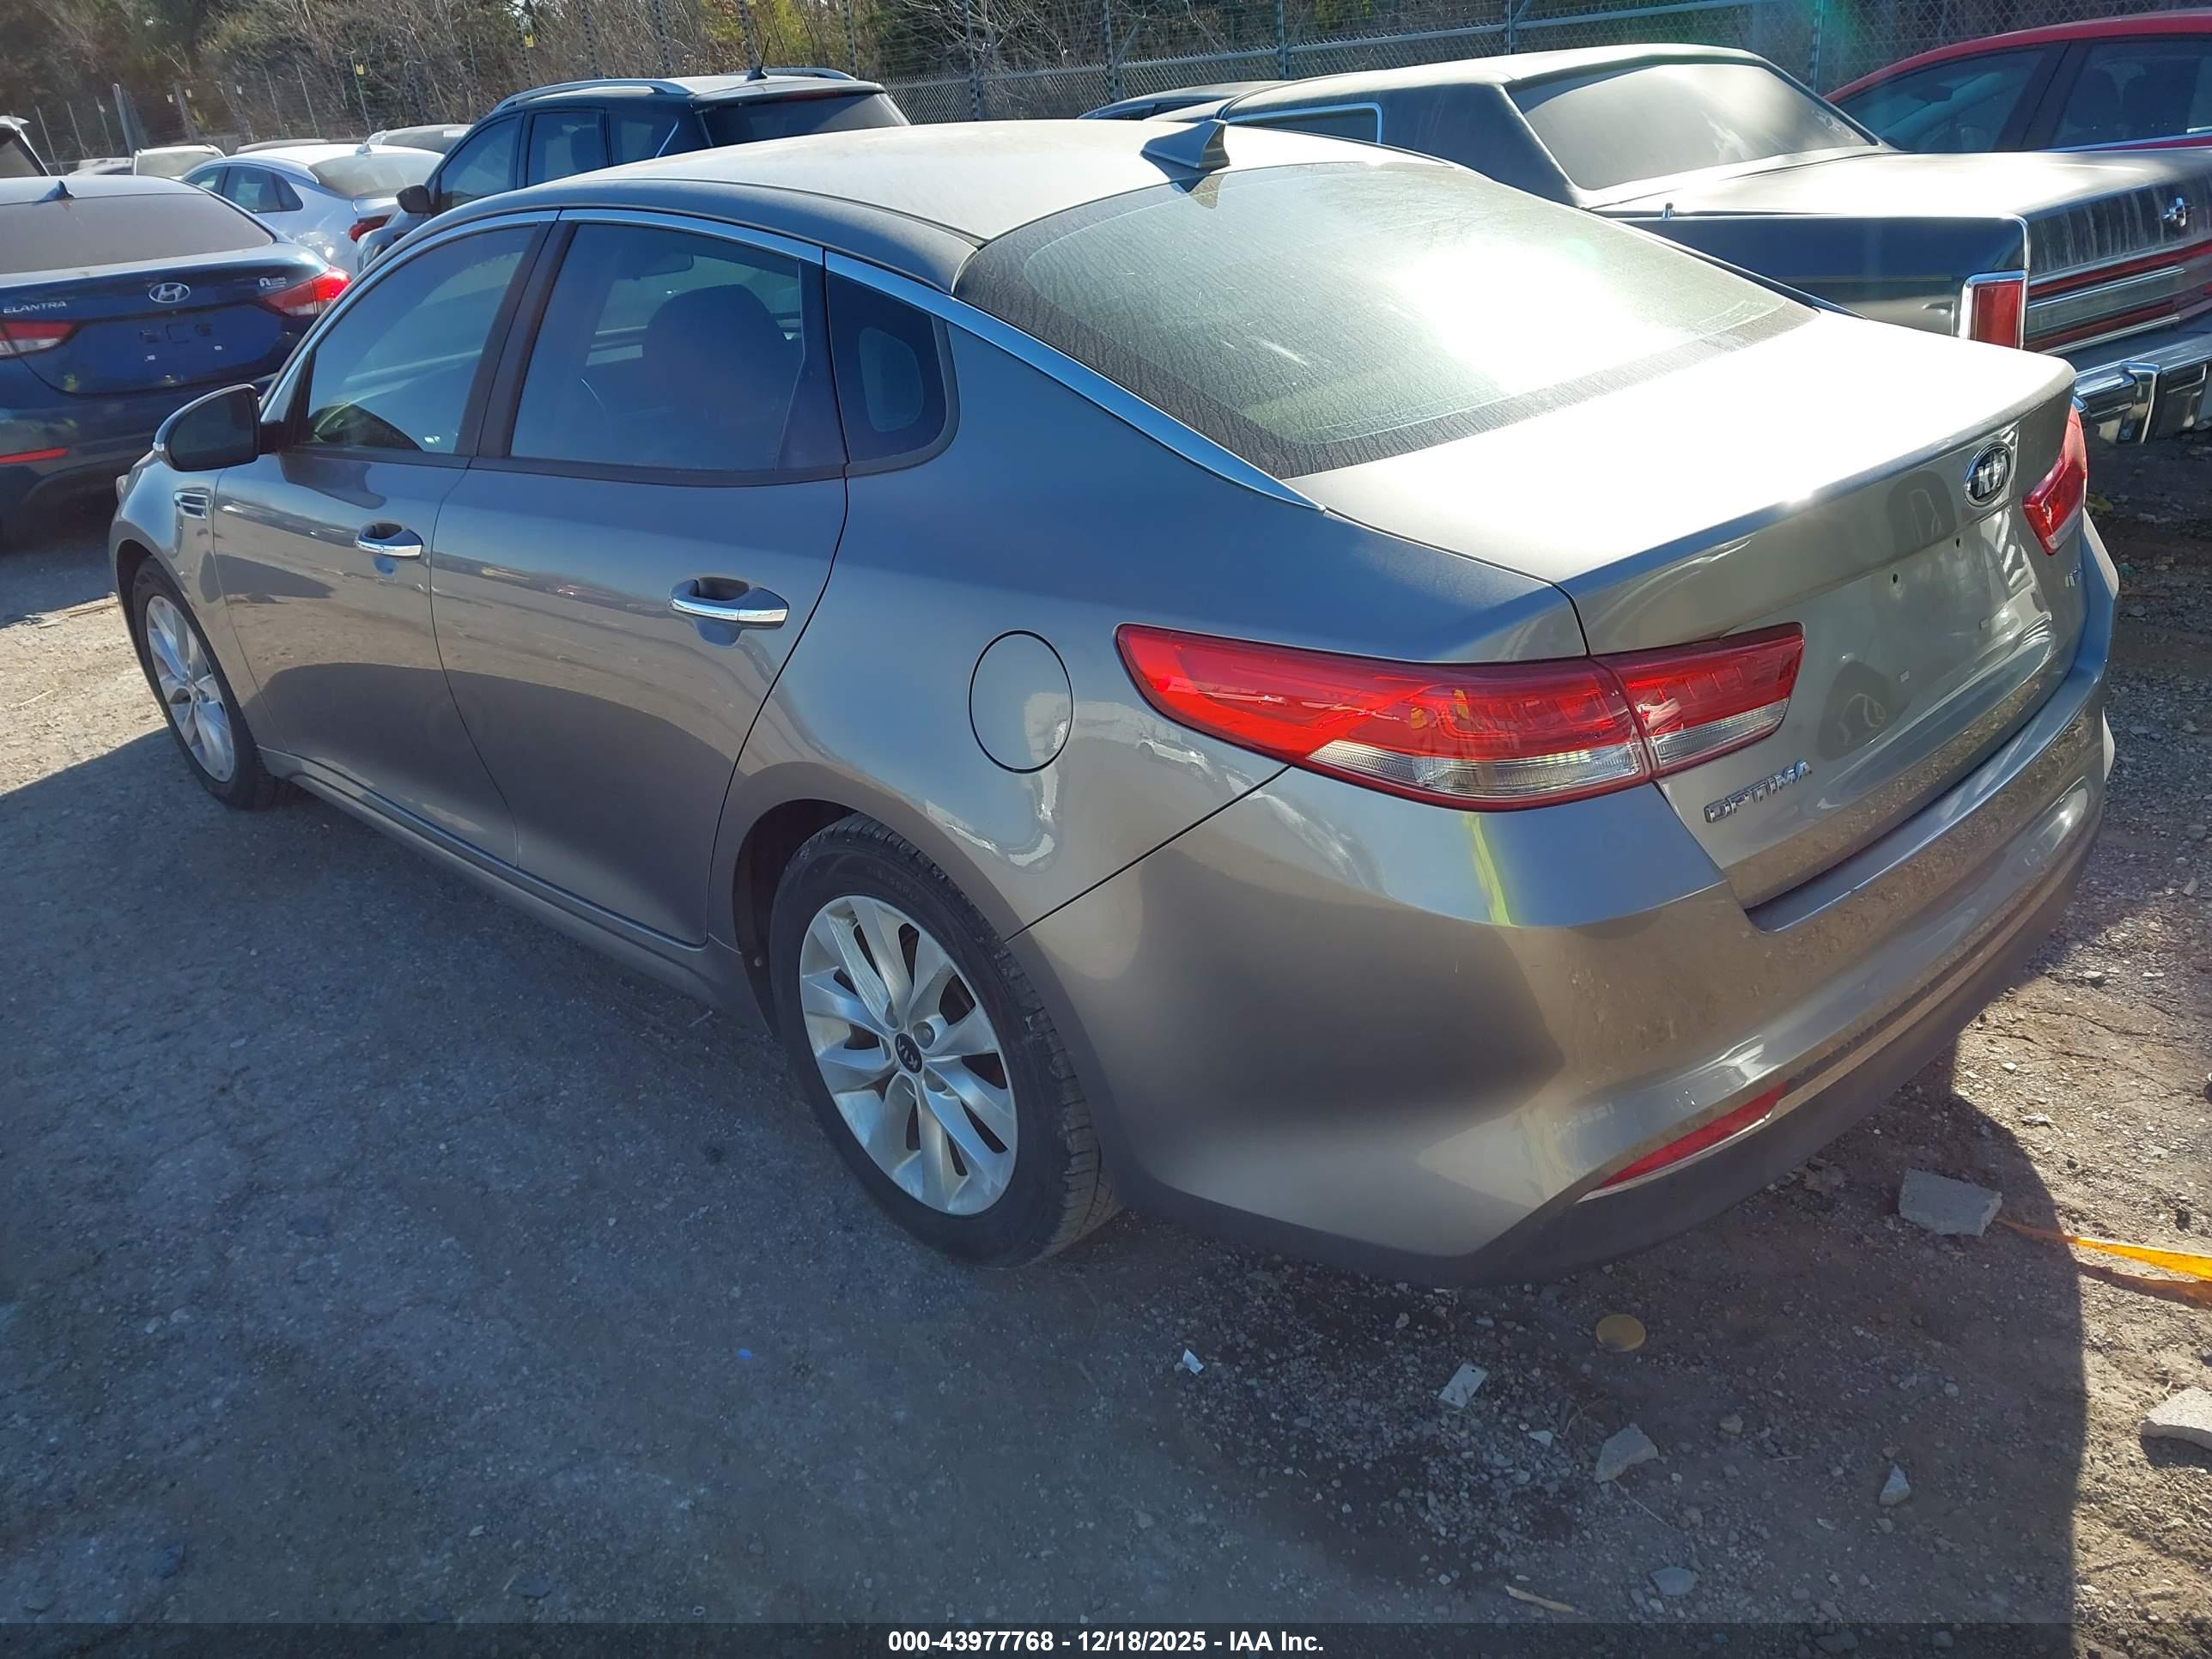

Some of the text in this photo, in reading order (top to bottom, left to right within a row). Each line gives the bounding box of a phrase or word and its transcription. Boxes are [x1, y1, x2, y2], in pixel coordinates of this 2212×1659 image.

[3, 301, 67, 314] ELANTRA
[1704, 760, 1813, 823] OPTIMA
[897, 1036, 919, 1069] KIA
